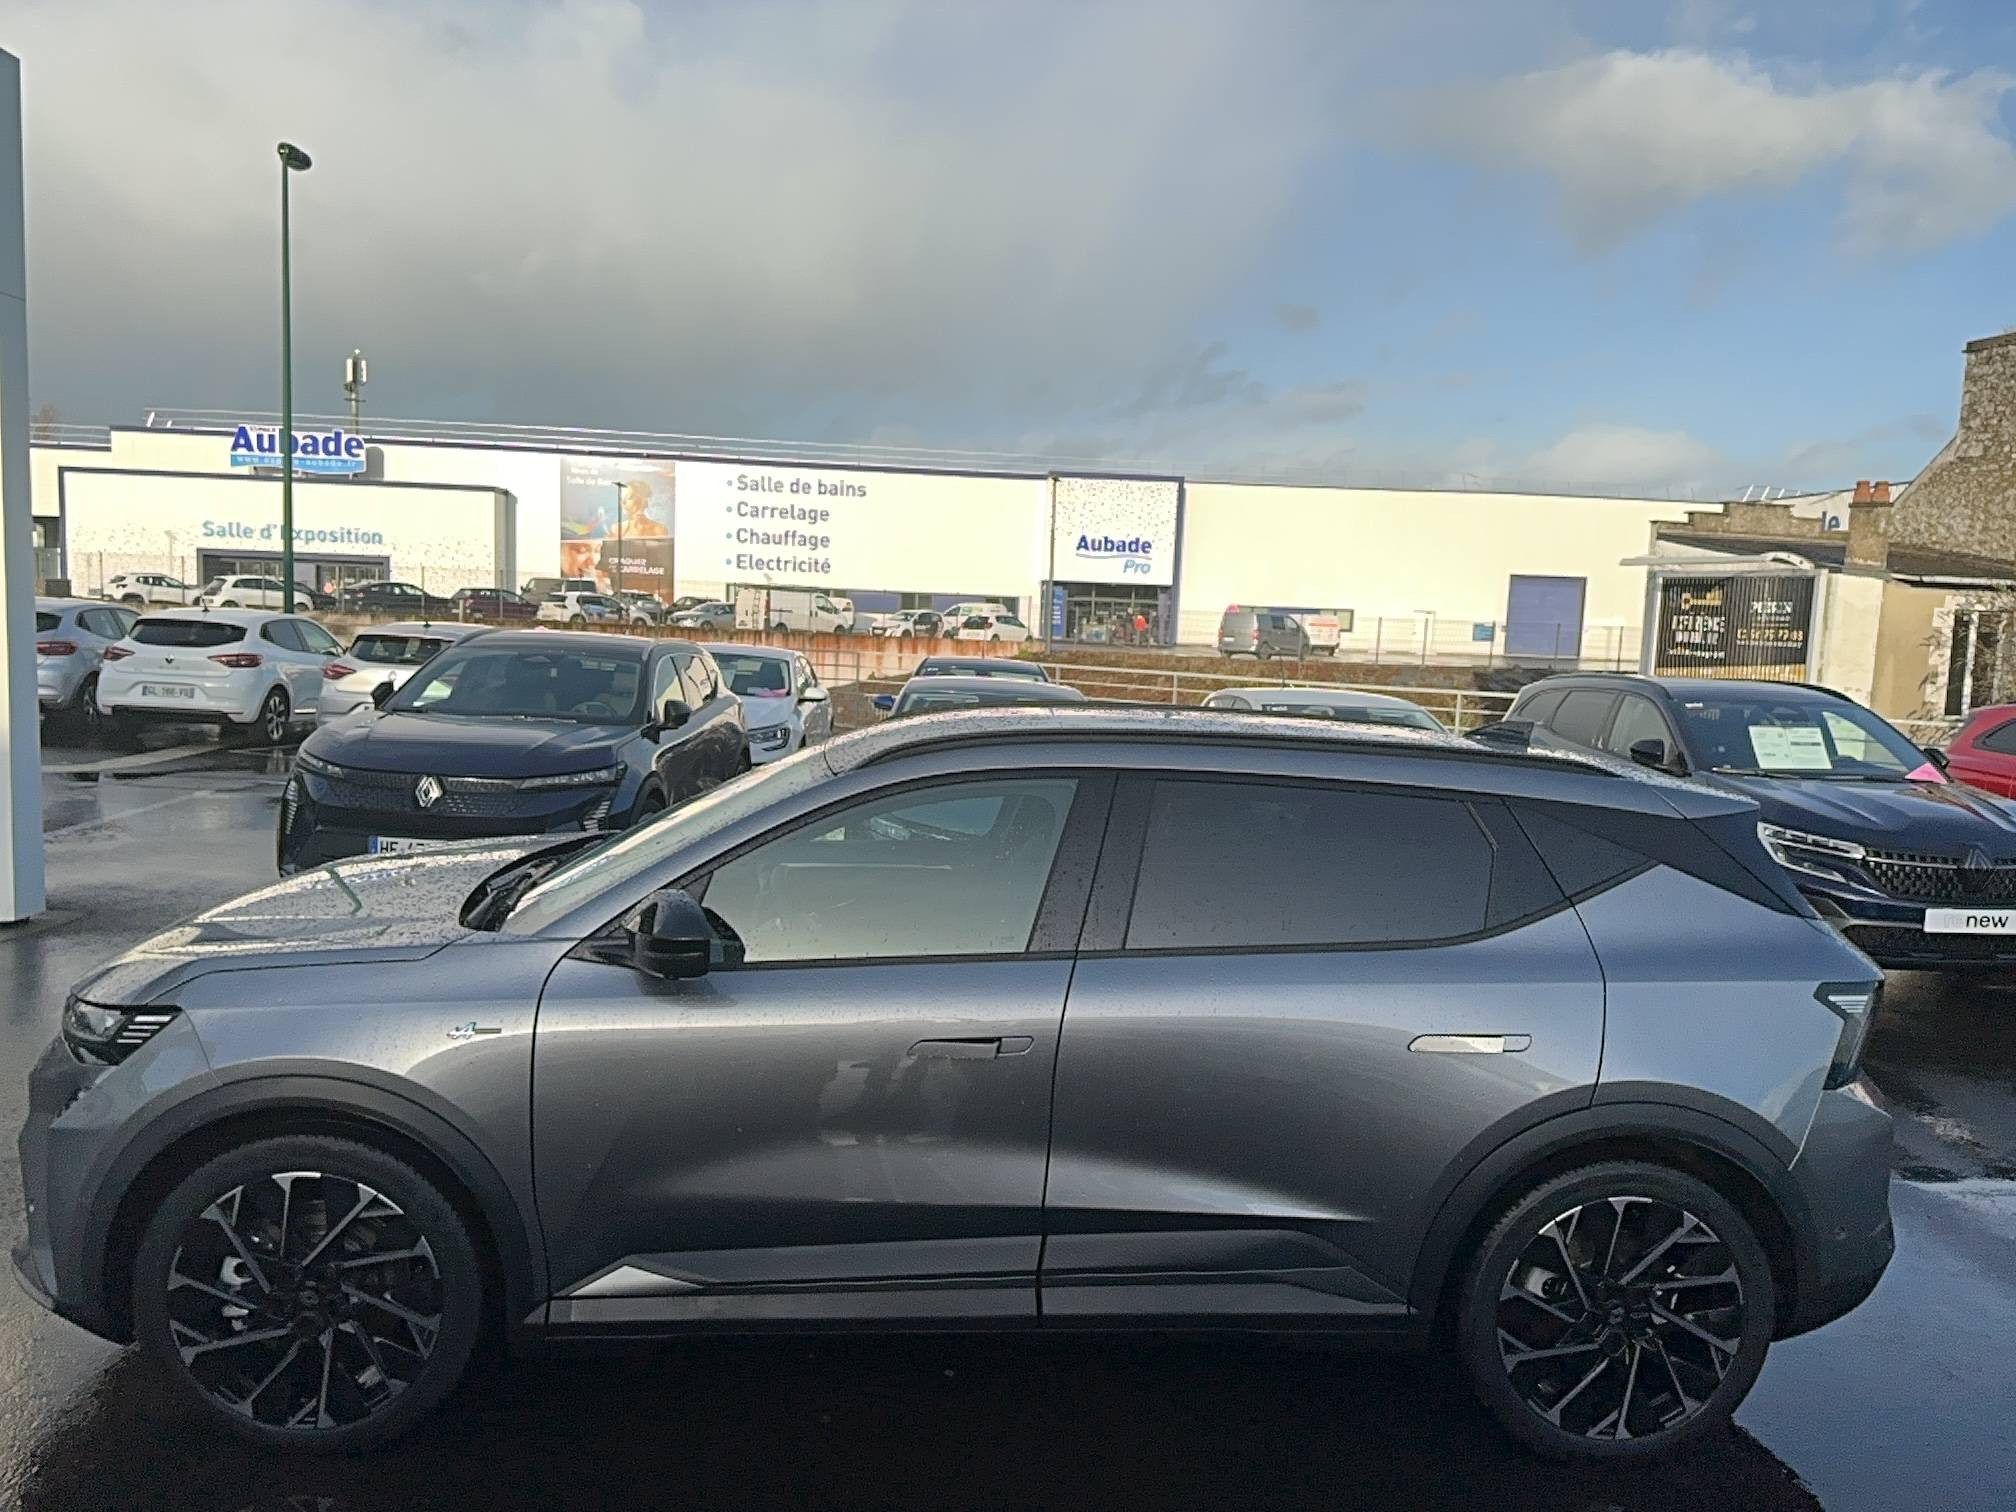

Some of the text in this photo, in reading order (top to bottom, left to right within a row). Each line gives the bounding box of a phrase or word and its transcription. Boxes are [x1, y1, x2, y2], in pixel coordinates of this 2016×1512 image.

[231, 426, 365, 457] Aubade
[737, 473, 867, 498] Salle de bains
[736, 501, 830, 525] Carrelage
[202, 520, 254, 538] Salle
[736, 528, 830, 551] Chauffage
[1076, 534, 1152, 554] Aubade
[736, 553, 831, 574] Electricité
[1123, 560, 1151, 575] Pro
